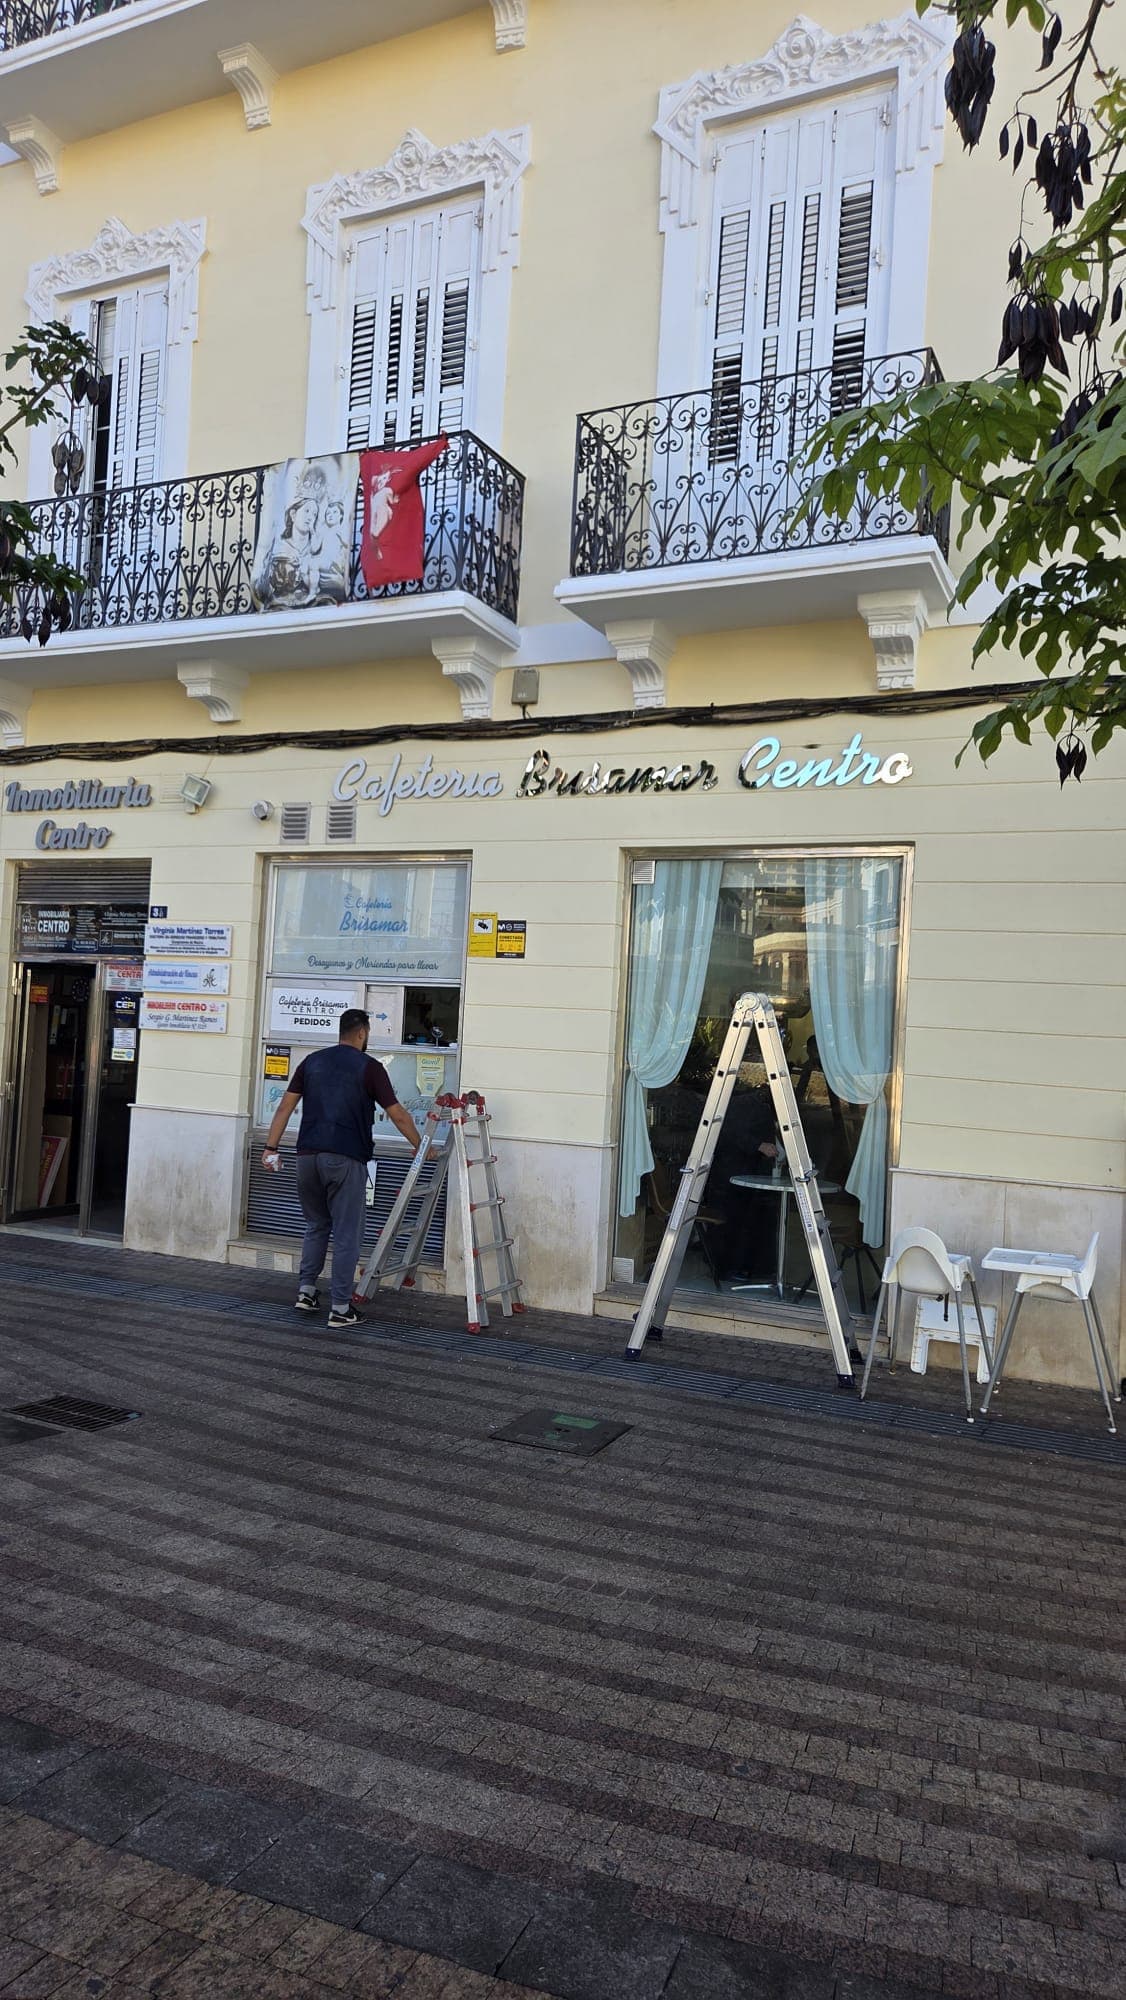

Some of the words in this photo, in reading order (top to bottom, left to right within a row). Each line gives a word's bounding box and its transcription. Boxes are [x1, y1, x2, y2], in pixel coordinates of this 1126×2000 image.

[738, 732, 913, 791] Centro
[5, 777, 152, 812] Inmobiliaria
[35, 820, 112, 850] Centro
[38, 920, 70, 933] CENTRO
[339, 911, 408, 932] Brisamar
[152, 926, 175, 935] Virginia
[204, 927, 224, 935] Torres
[307, 955, 346, 970] Desayunos
[346, 961, 353, 969] y
[354, 956, 396, 970] Meriendas
[396, 961, 416, 972] para
[416, 960, 439, 970] llevar
[116, 1000, 136, 1009] CEPI
[177, 1002, 207, 1011] CENTRO
[311, 997, 349, 1009] Brisamar
[291, 1005, 335, 1015] CENTRO
[293, 1017, 332, 1027] PEDIDOS
